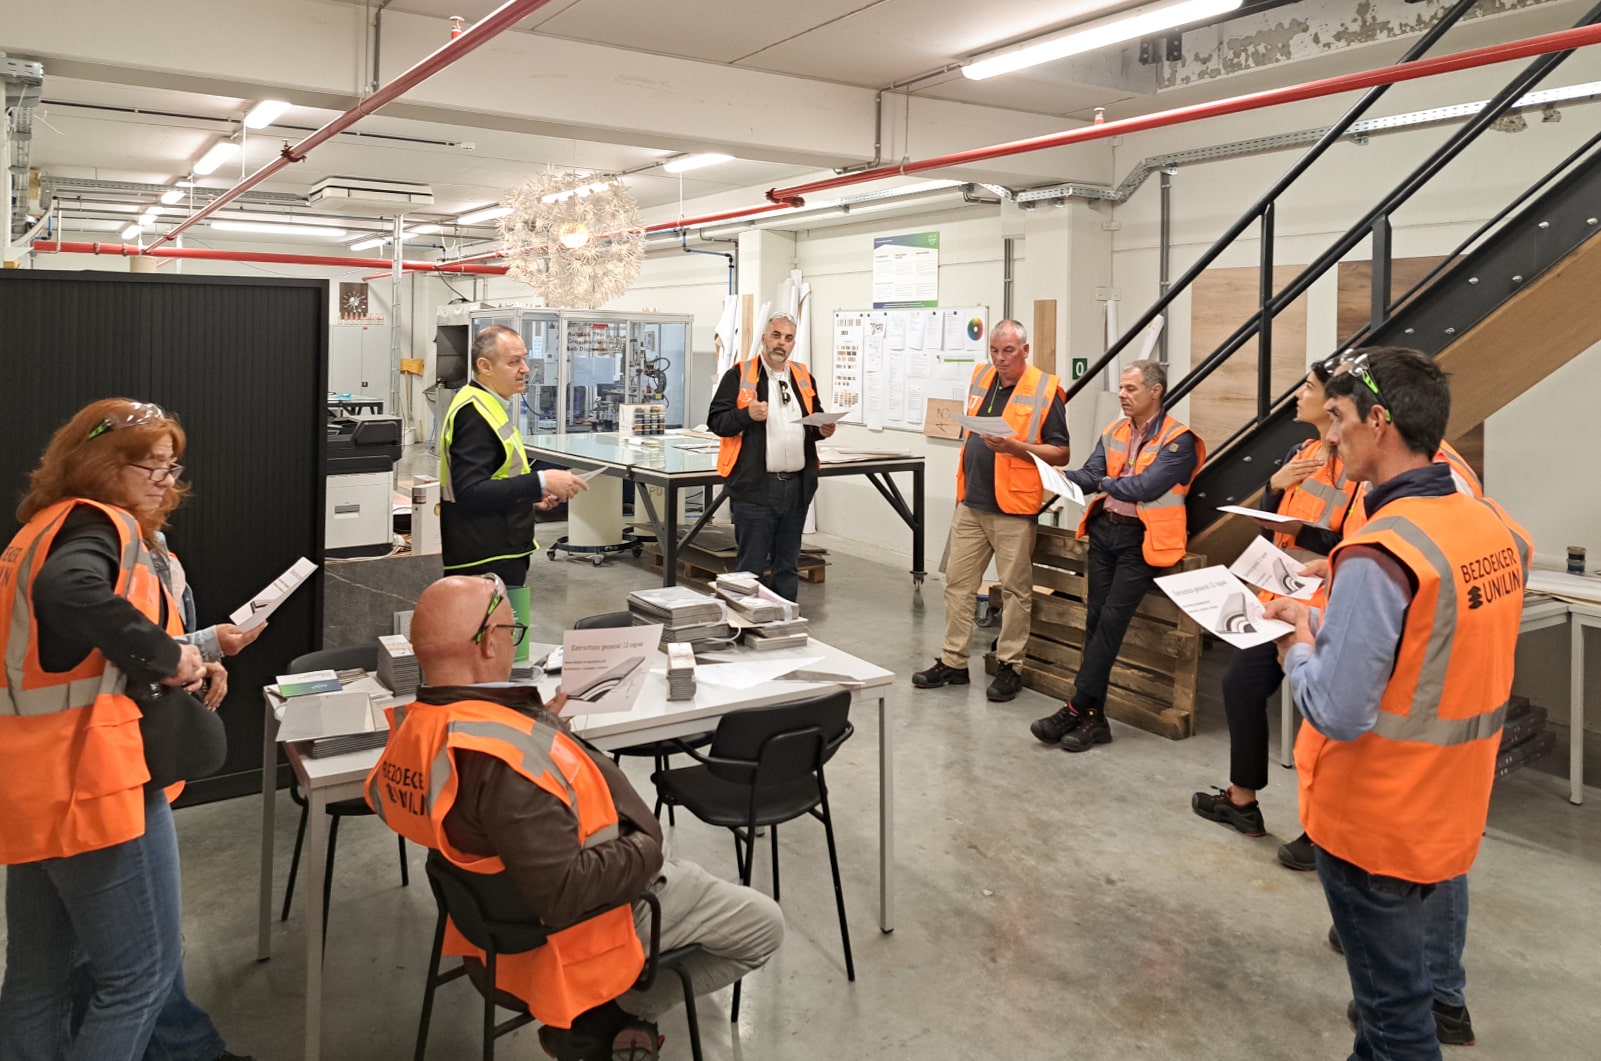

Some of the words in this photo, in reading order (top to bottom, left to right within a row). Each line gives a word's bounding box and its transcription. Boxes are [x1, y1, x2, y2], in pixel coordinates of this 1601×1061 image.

[1460, 547, 1517, 583] BEZOEKER
[1483, 568, 1521, 603] UNILIN
[382, 760, 425, 790] BEZOEKE
